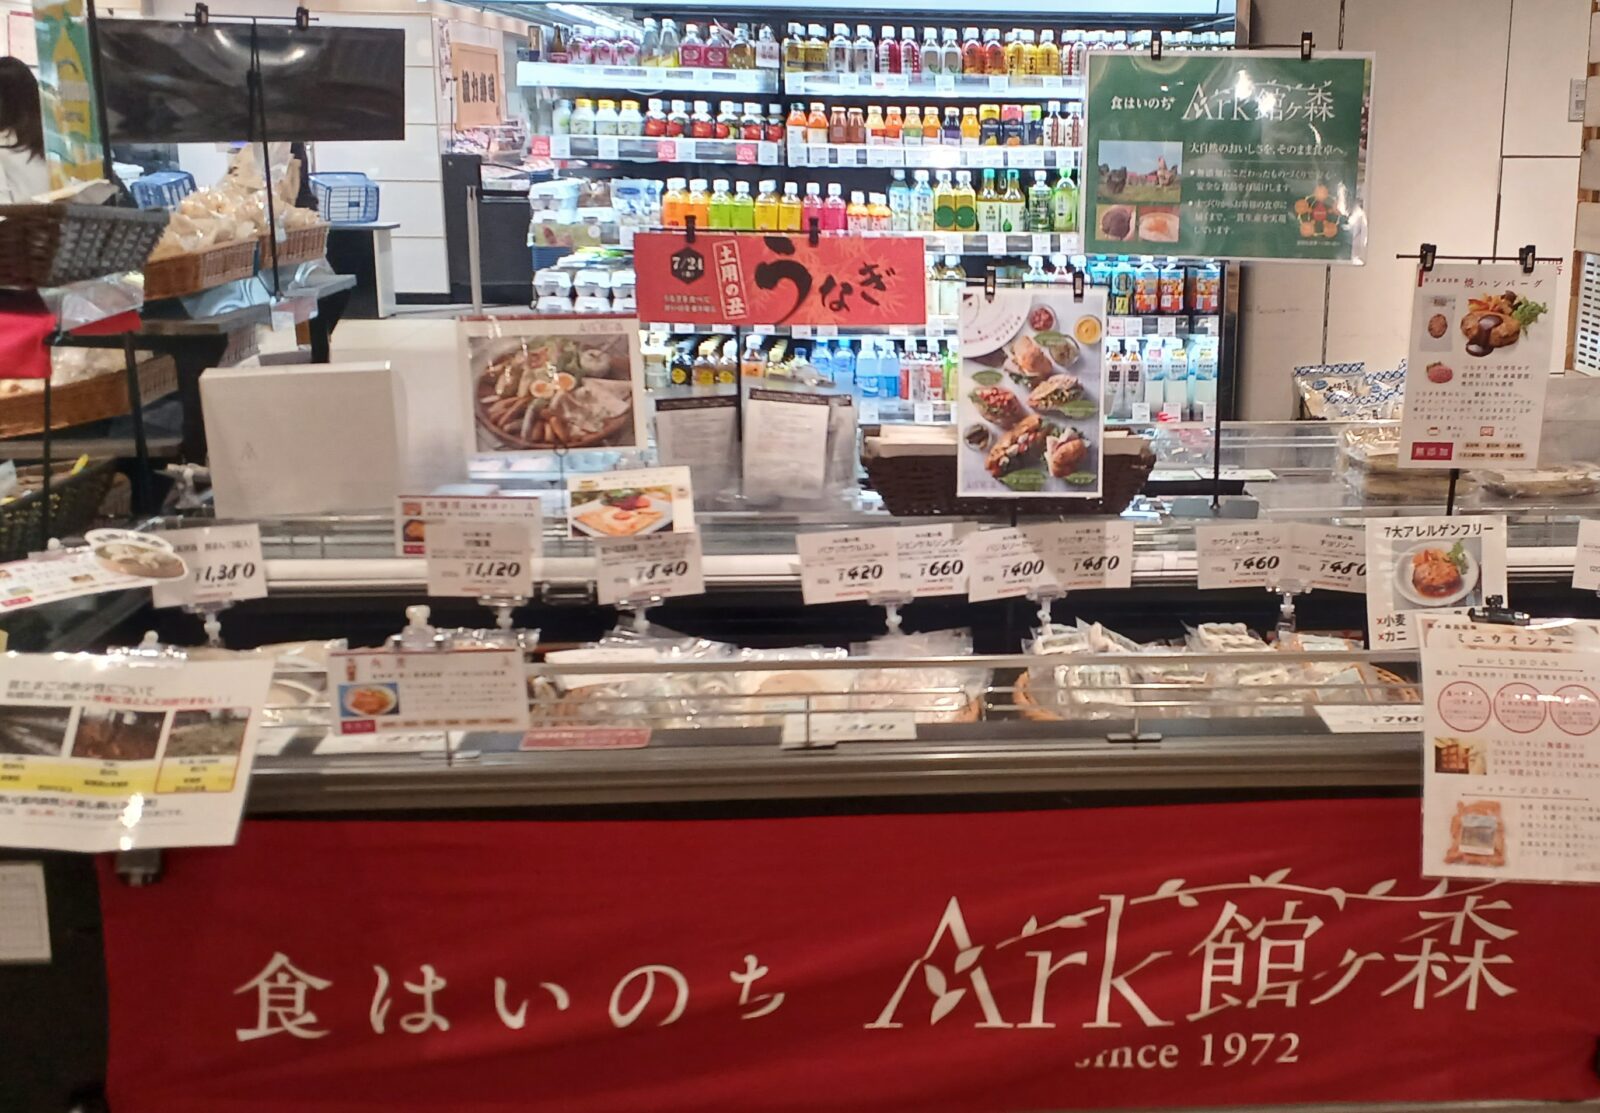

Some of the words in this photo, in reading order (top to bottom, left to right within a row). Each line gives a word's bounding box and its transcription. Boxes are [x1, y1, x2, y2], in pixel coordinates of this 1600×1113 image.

[1111, 96, 1173, 111] 食はいのち
[719, 245, 745, 316] 土用の丑
[754, 236, 897, 324] うなぎ
[1384, 523, 1494, 538] 7大アレルゲンフリー
[1458, 634, 1574, 646] ミニウインナー
[233, 952, 786, 1042] 食はいのち
[864, 893, 1519, 1029] Ark館ヶ森
[1200, 1032, 1300, 1067] 1972
